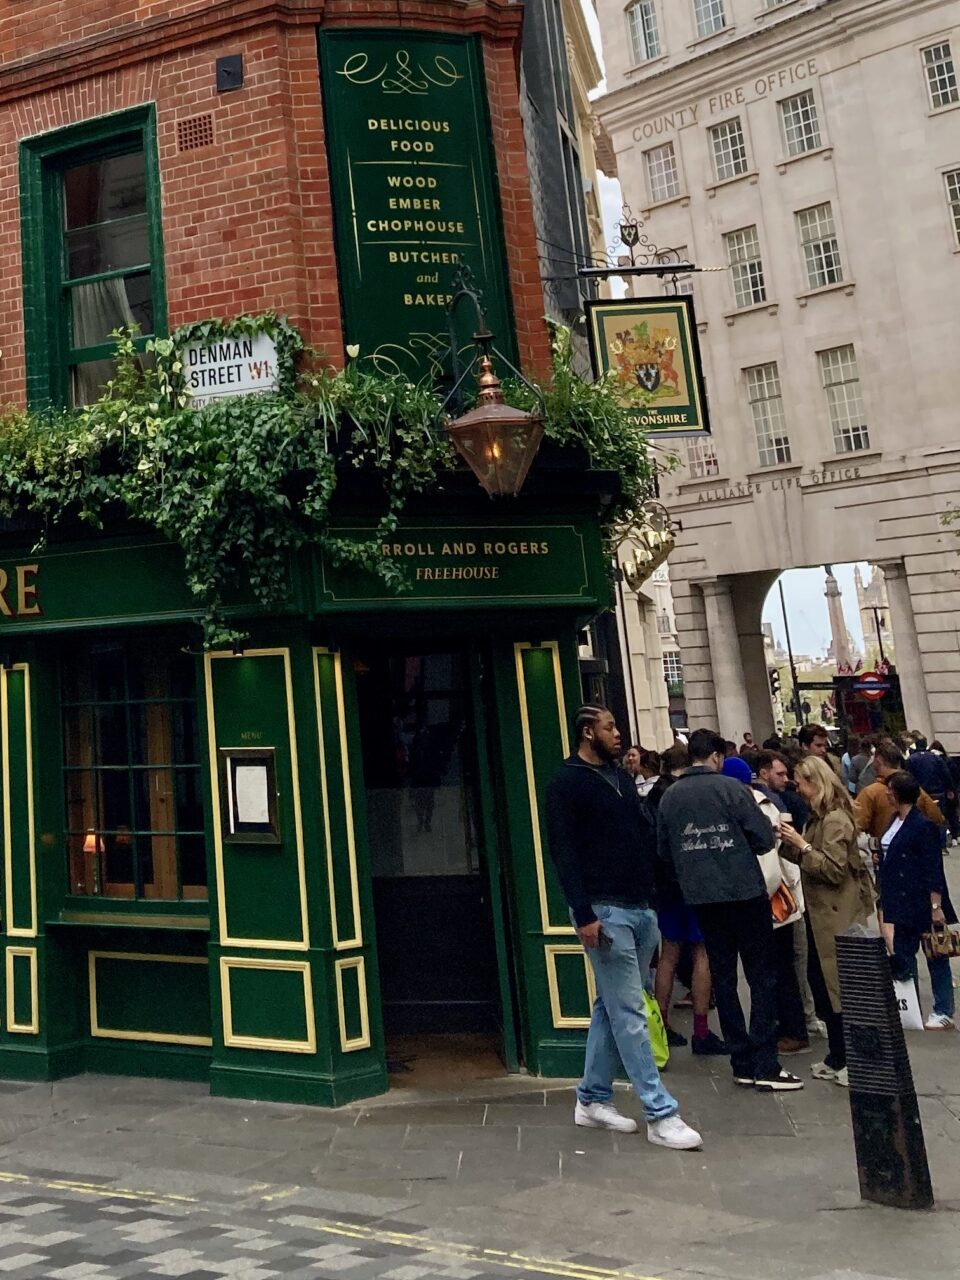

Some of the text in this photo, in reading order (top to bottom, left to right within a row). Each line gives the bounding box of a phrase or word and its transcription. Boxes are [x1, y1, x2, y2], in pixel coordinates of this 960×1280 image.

[632, 58, 817, 142] COUNTY FIRE OFFICE
[368, 119, 450, 133] DELICIOUS
[391, 141, 435, 153] FOOD
[387, 176, 437, 188] WOOD
[389, 198, 440, 210] EMBER
[367, 220, 464, 233] CHOPHOUSE
[416, 272, 439, 283] and
[189, 340, 253, 366] DENMAN
[190, 360, 269, 388] STREET W1
[624, 414, 688, 426] EVONSHIRE
[697, 467, 861, 503] ALLIANCE LIFE OFFICE
[382, 541, 549, 556] RROLL AND ROGERS
[416, 566, 499, 580] FREEHOUSE
